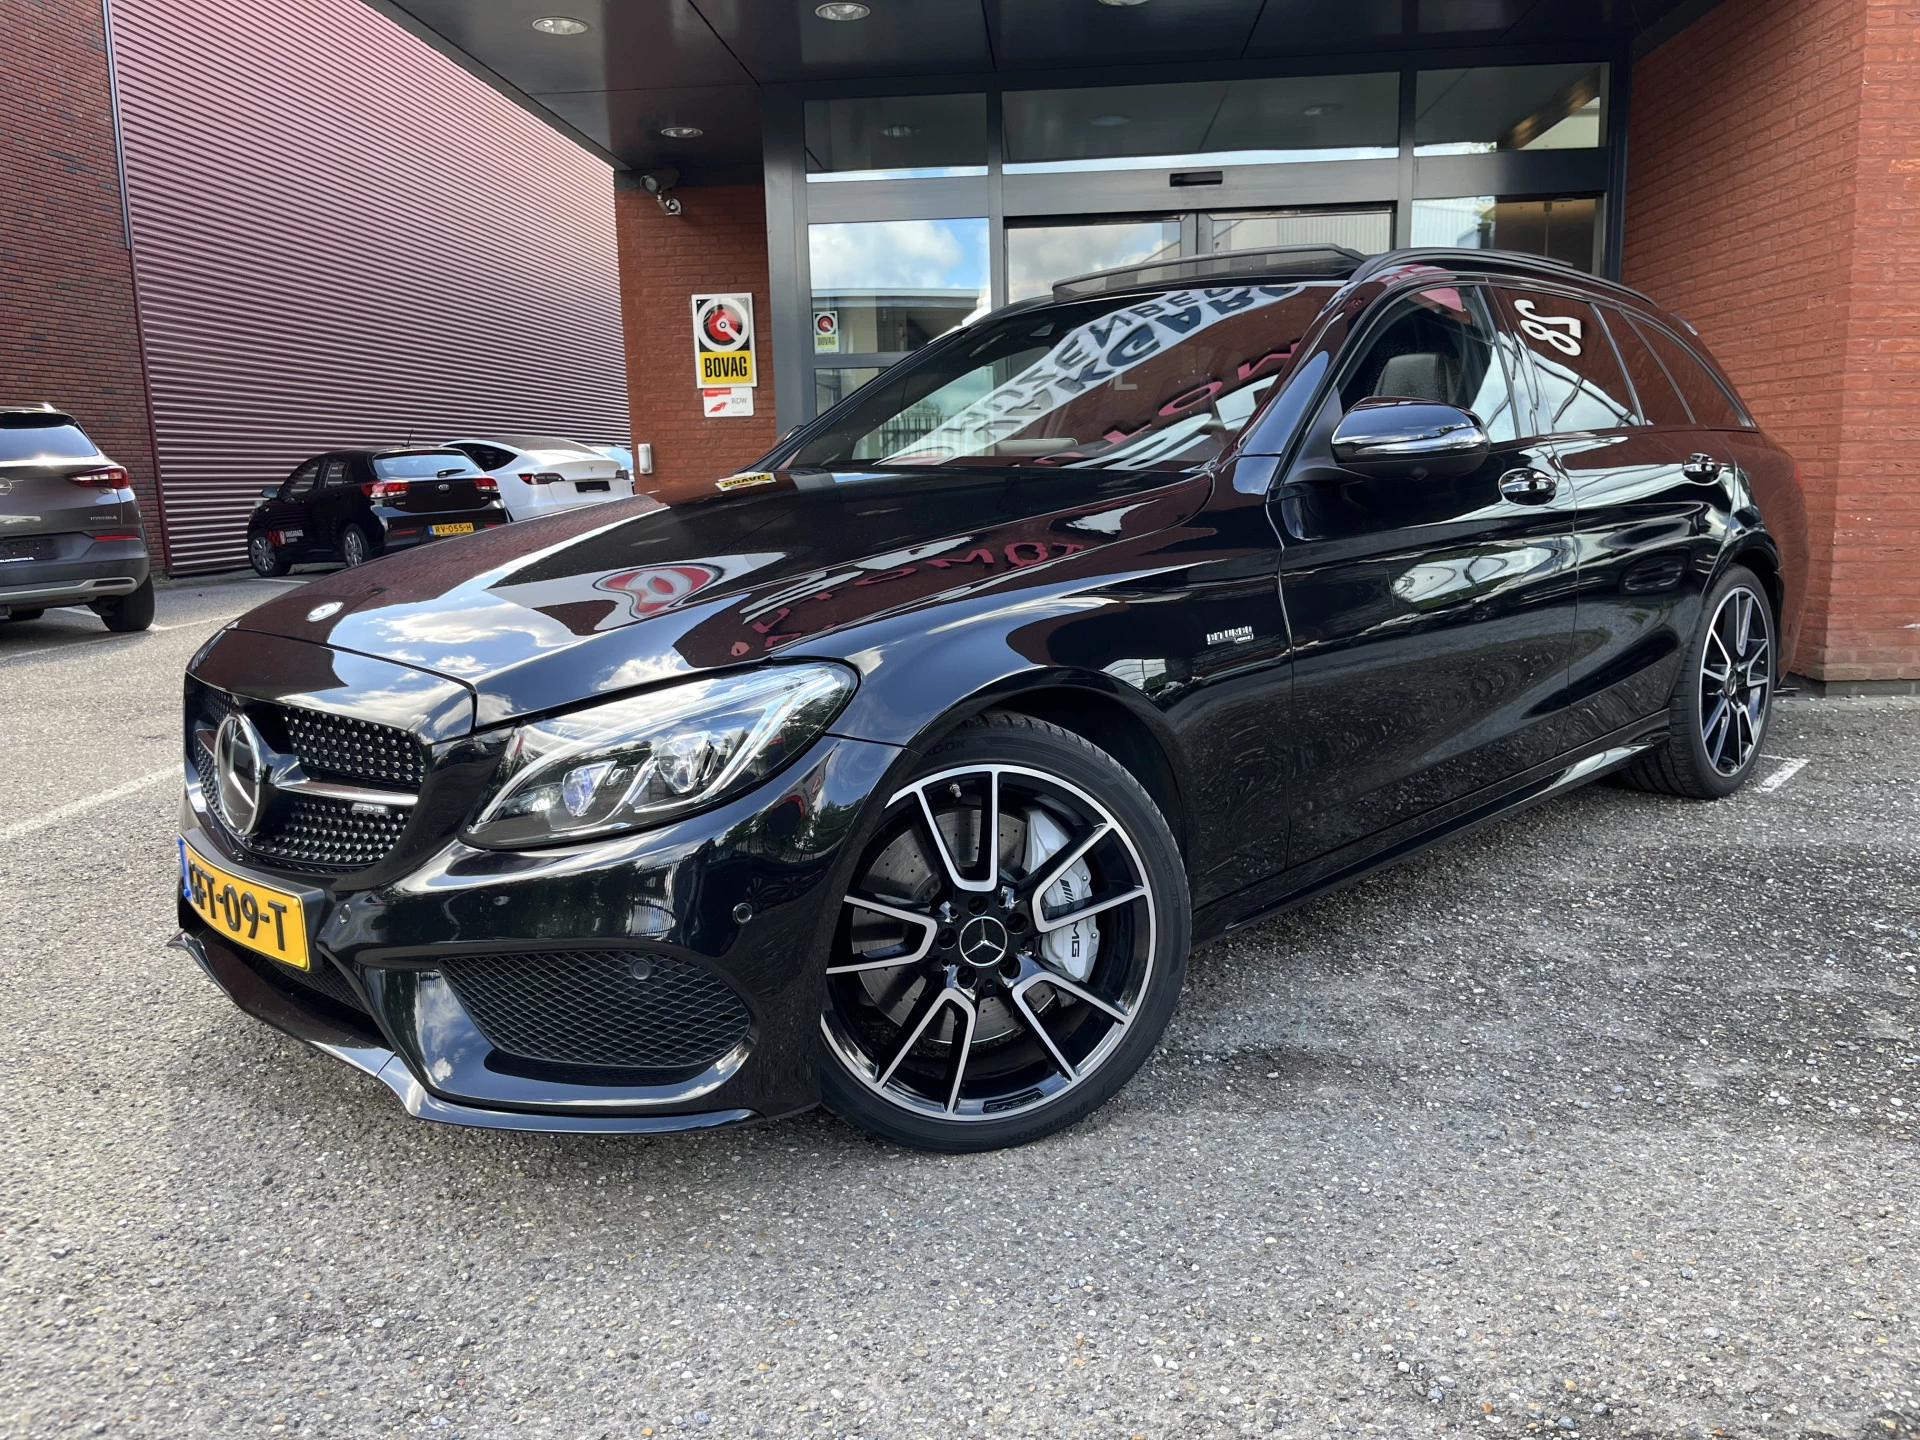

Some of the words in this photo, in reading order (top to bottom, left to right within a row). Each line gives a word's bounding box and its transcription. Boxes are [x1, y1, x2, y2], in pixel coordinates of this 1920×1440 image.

[817, 336, 836, 346] BOVAG
[704, 356, 747, 378] BOVAG
[435, 522, 472, 534] RV-055-H
